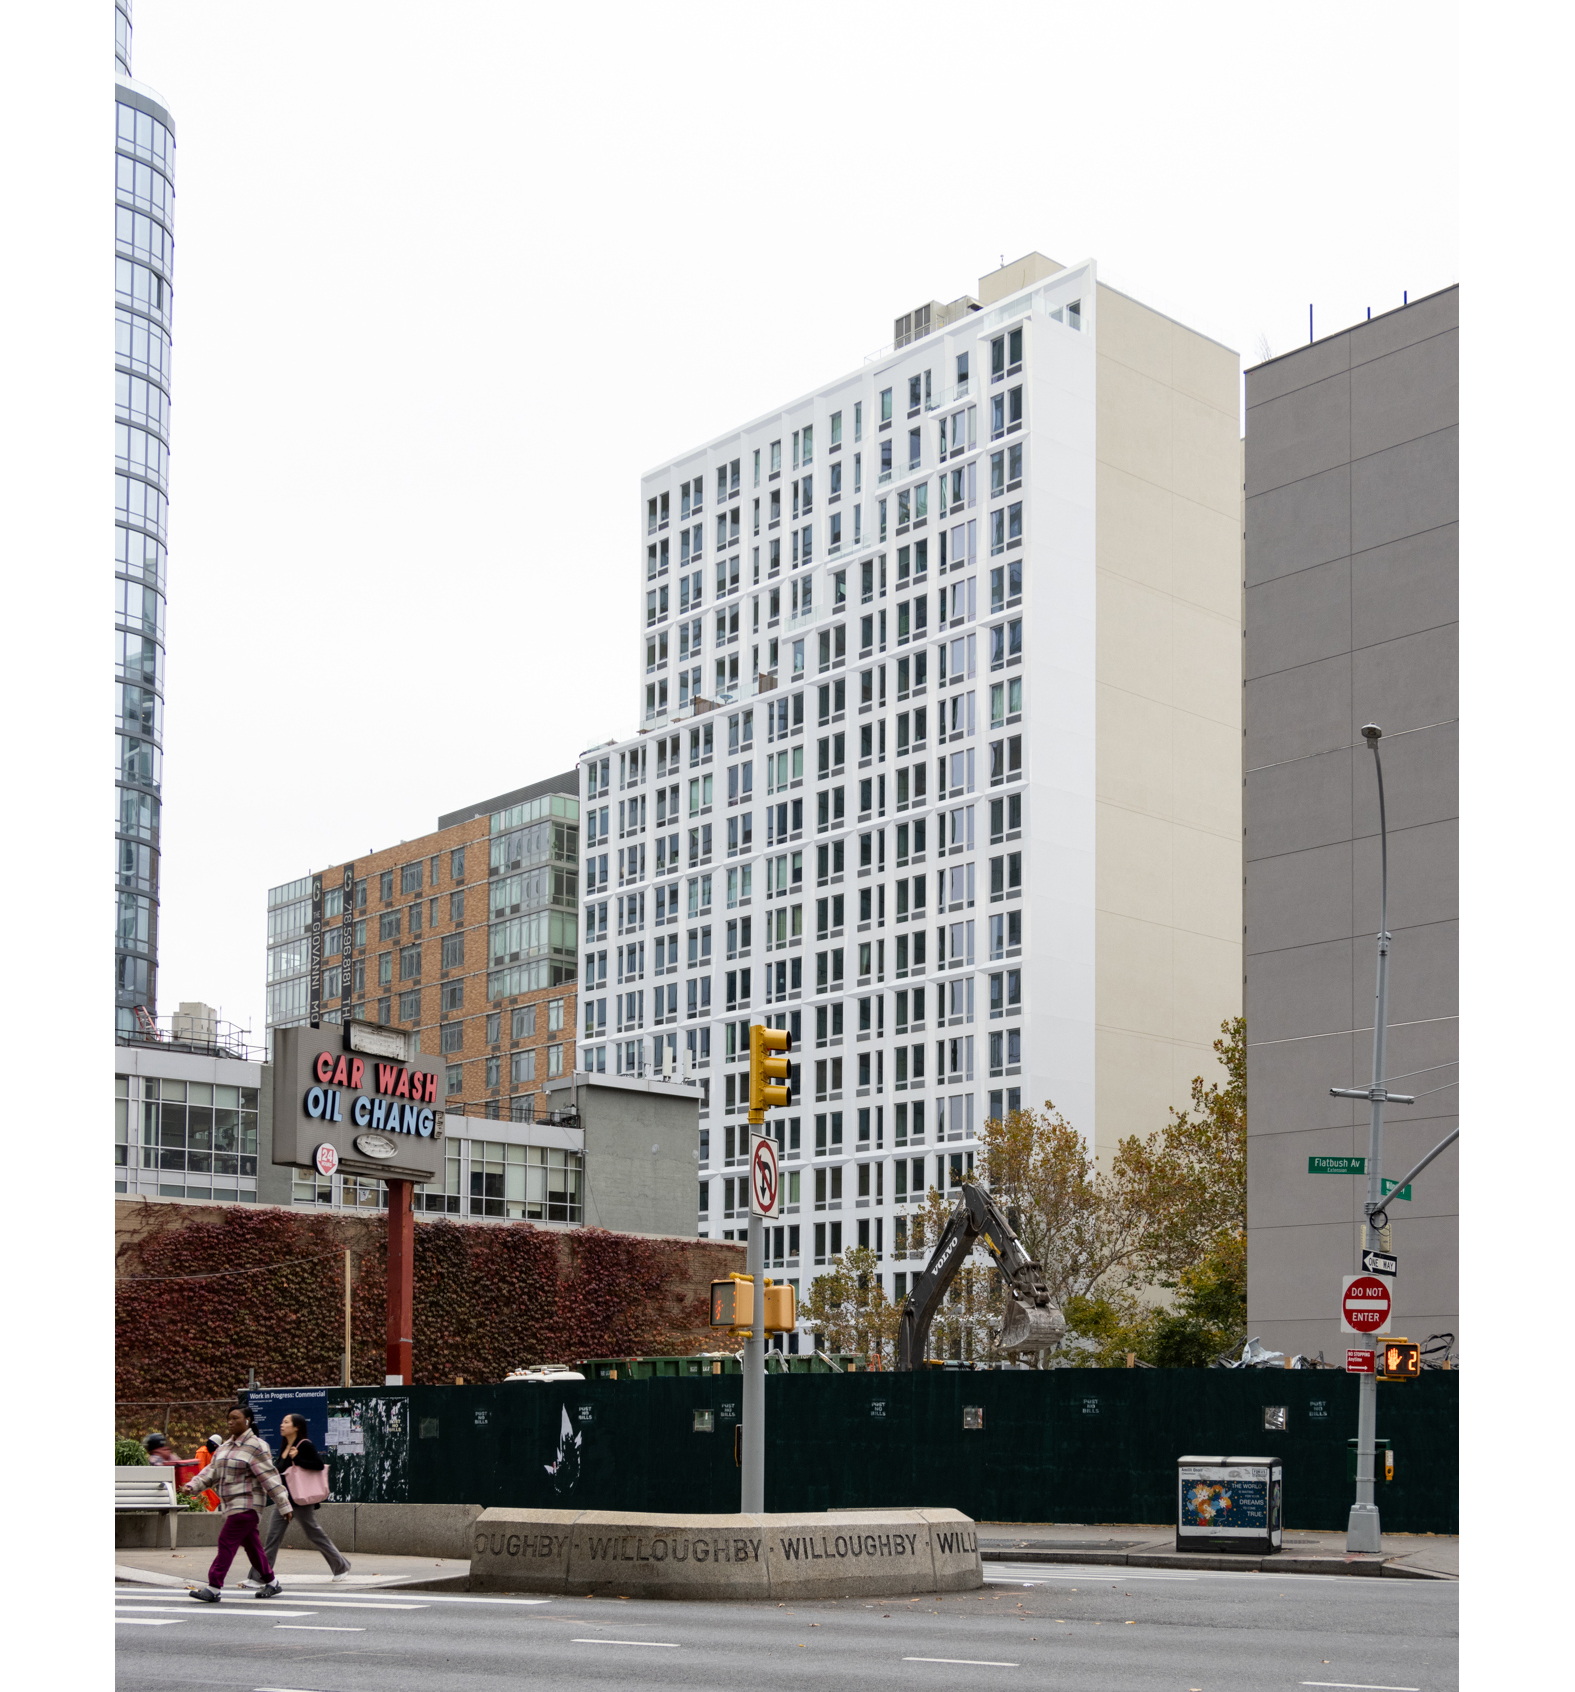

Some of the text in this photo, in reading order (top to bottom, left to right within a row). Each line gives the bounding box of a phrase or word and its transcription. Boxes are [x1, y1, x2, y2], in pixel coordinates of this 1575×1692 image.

[342, 901, 352, 986] 718.596.8181
[311, 922, 321, 989] GIOVANNI
[315, 1051, 438, 1103] CAR WASH
[306, 1086, 343, 1122] OIL
[322, 1149, 333, 1162] 24
[1314, 1158, 1360, 1168] Flatbush Av
[931, 1236, 958, 1276] VOLVO
[1369, 1257, 1393, 1270] ONE WAY
[1351, 1287, 1383, 1296] DO NOT
[1352, 1312, 1379, 1322] ENTER
[1407, 1351, 1417, 1371] 2
[271, 1392, 295, 1400] Progress:
[295, 1390, 326, 1398] Commercial
[475, 1533, 569, 1558] OUGHBY
[588, 1537, 762, 1562] WILLOUGHBY
[779, 1533, 917, 1561] WILLOUGHBY
